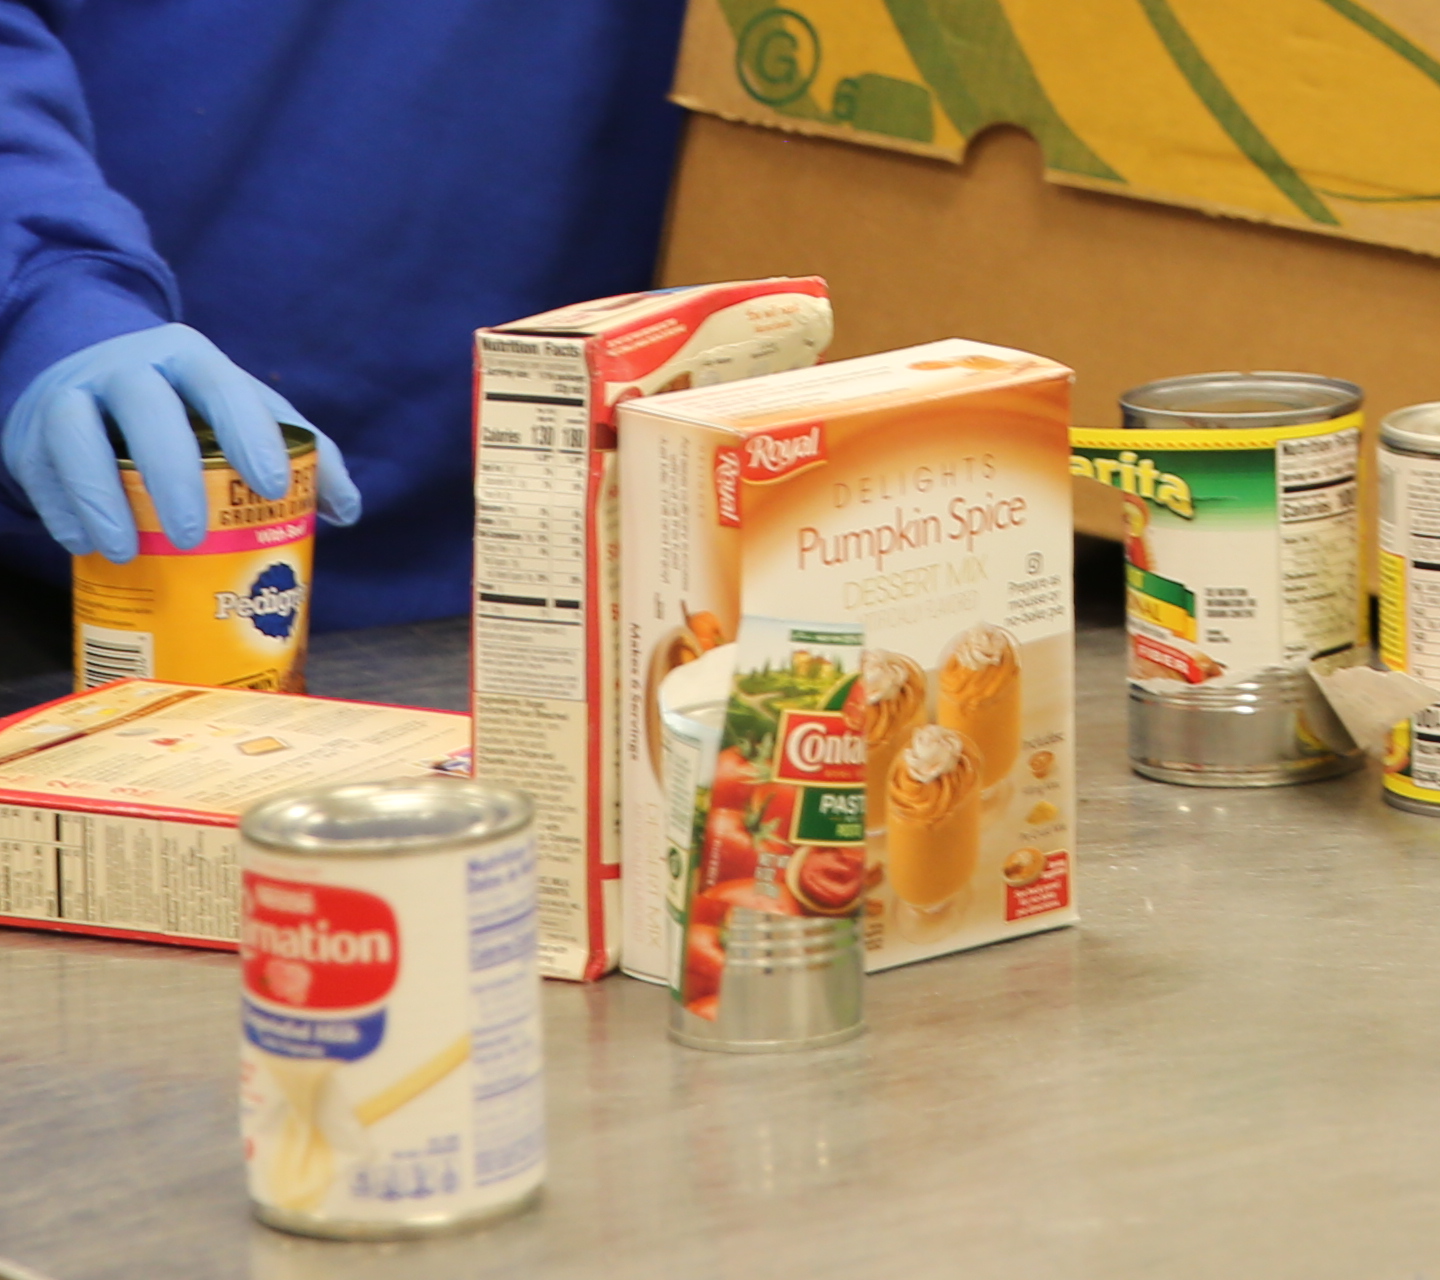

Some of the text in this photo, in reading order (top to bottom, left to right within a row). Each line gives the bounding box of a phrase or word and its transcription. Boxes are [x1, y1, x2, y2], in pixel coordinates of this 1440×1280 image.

[748, 425, 820, 473] Royal
[716, 451, 741, 522] Royal
[833, 452, 997, 508] DELIGHTS
[798, 491, 1028, 573] Pumpkin Spice
[844, 555, 988, 611] DESSERT MIX
